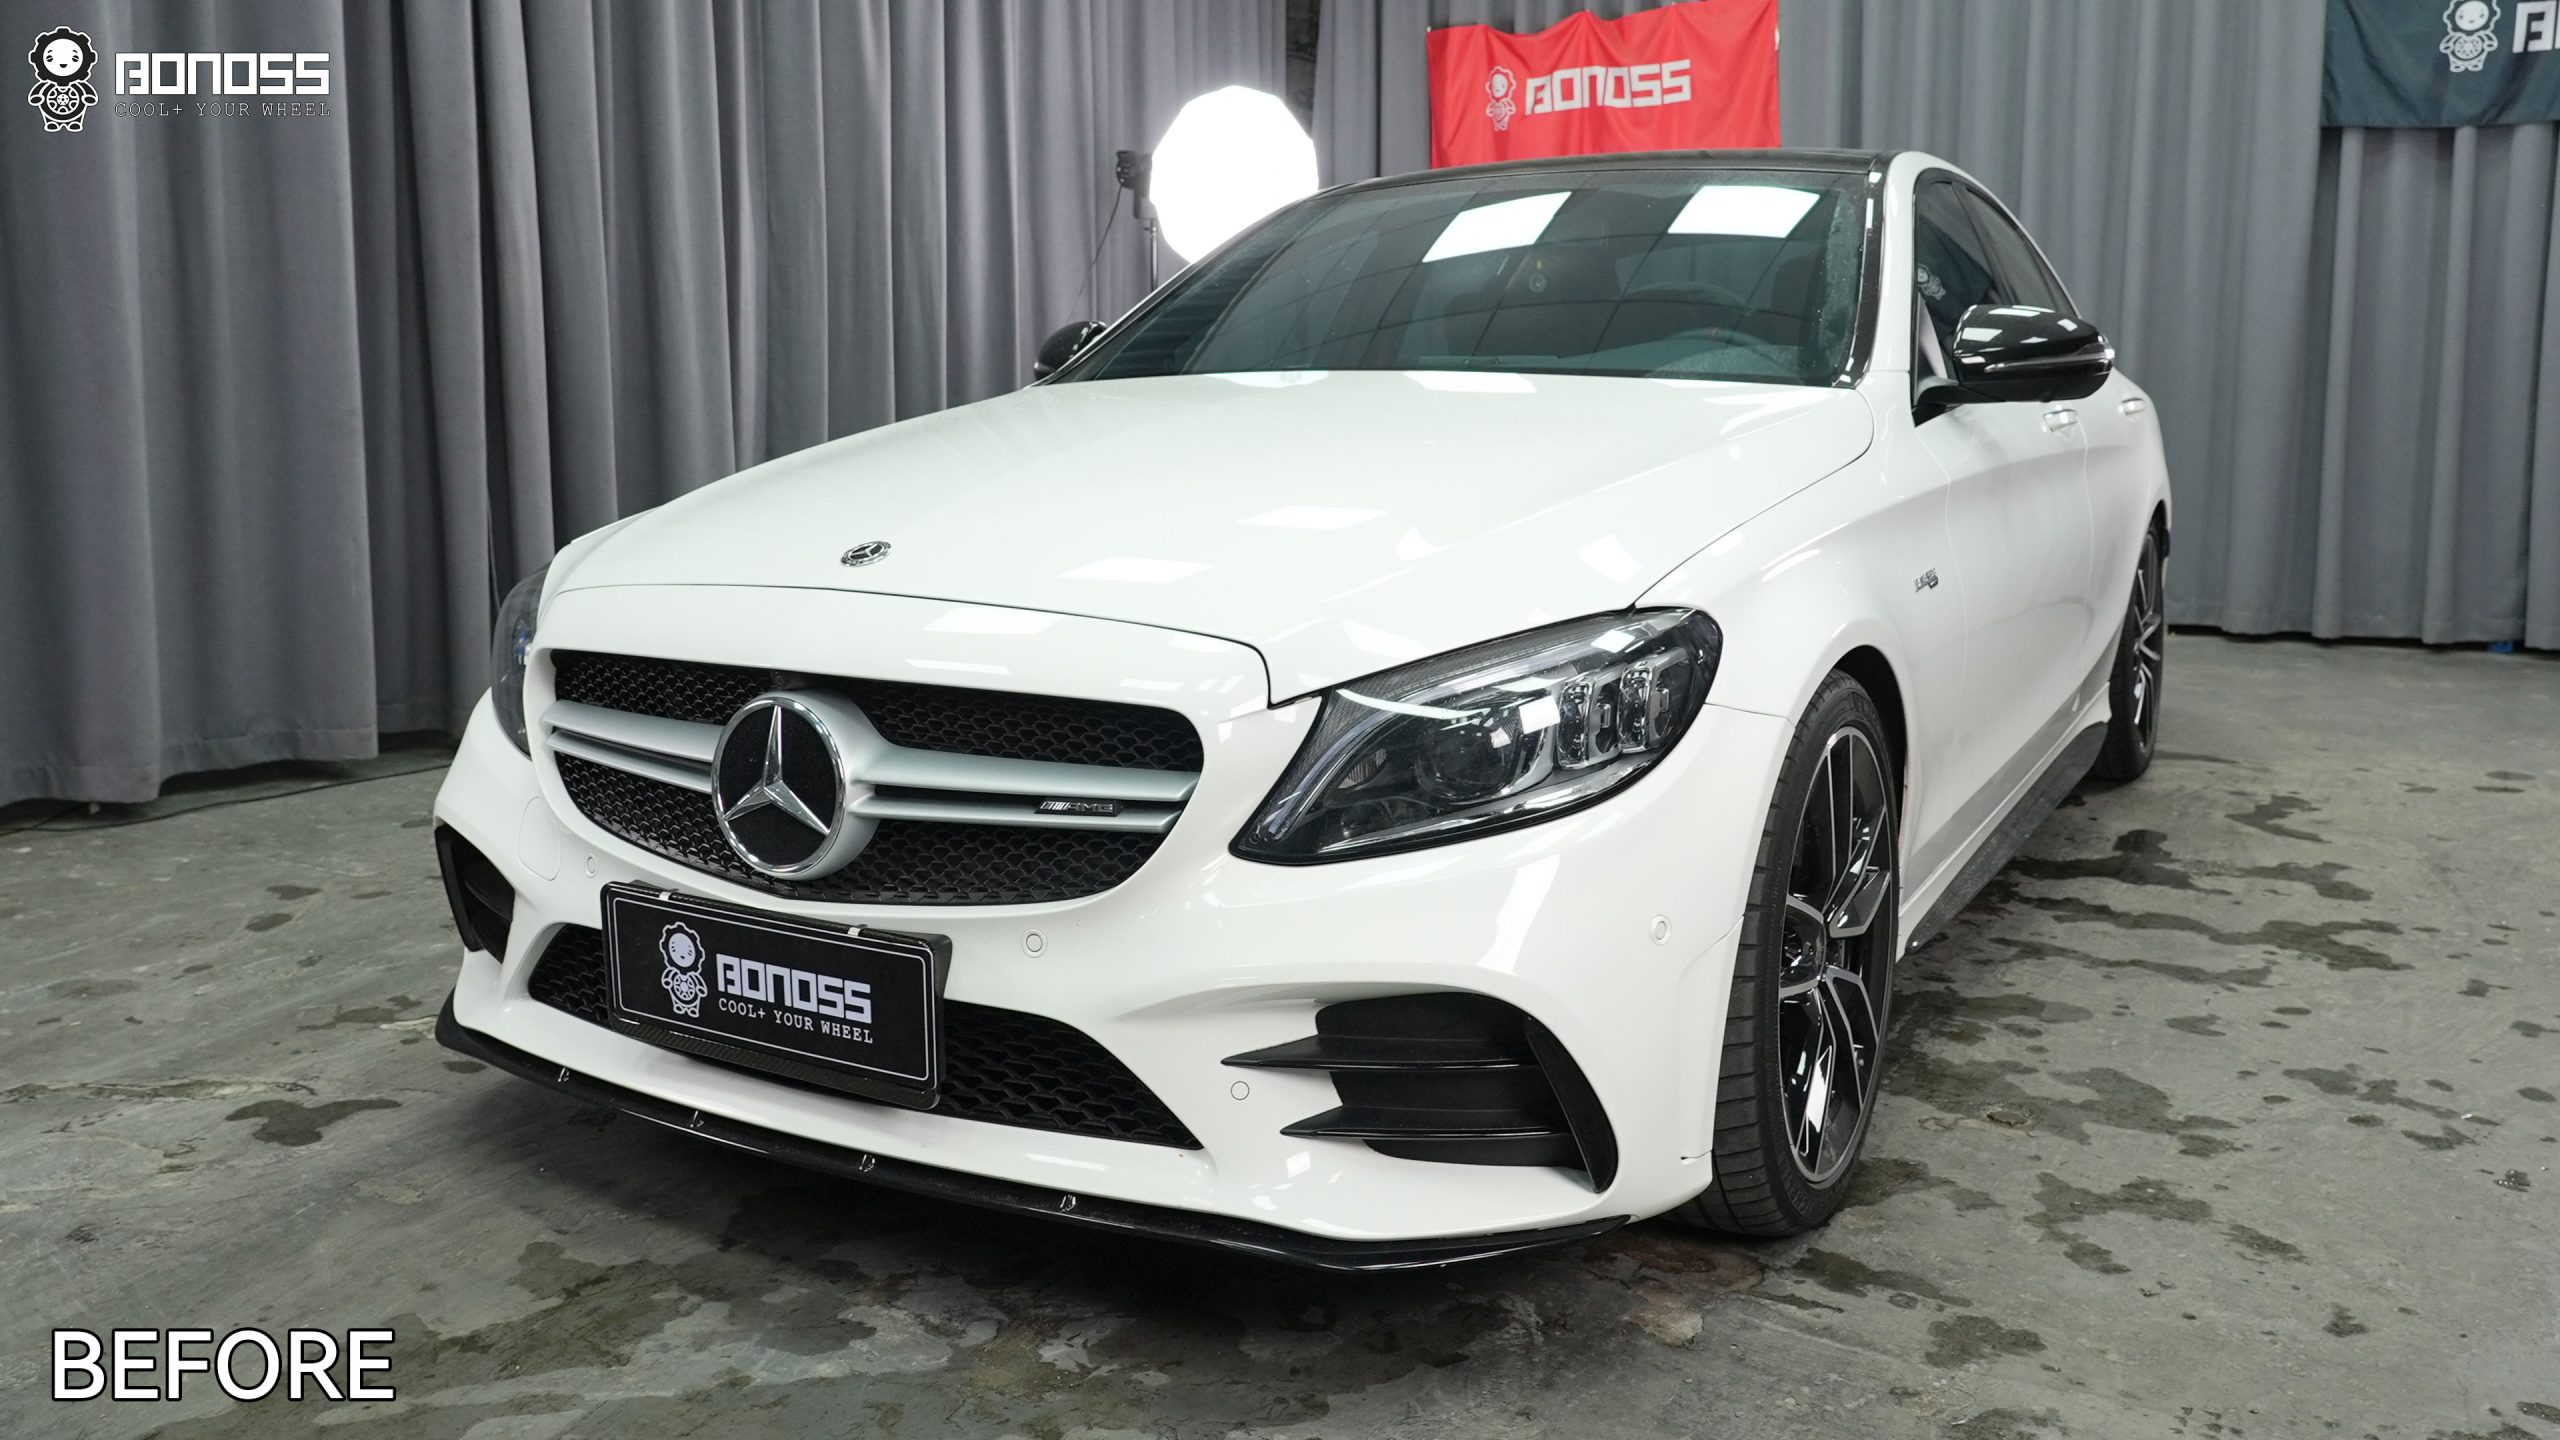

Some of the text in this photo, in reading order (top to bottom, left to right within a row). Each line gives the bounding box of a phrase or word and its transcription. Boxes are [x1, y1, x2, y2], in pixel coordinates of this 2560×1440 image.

[1525, 59, 1692, 116] BONOSS
[716, 953, 872, 1024] BONOSS
[718, 998, 873, 1044] COOL+ YOUR WHEEL
